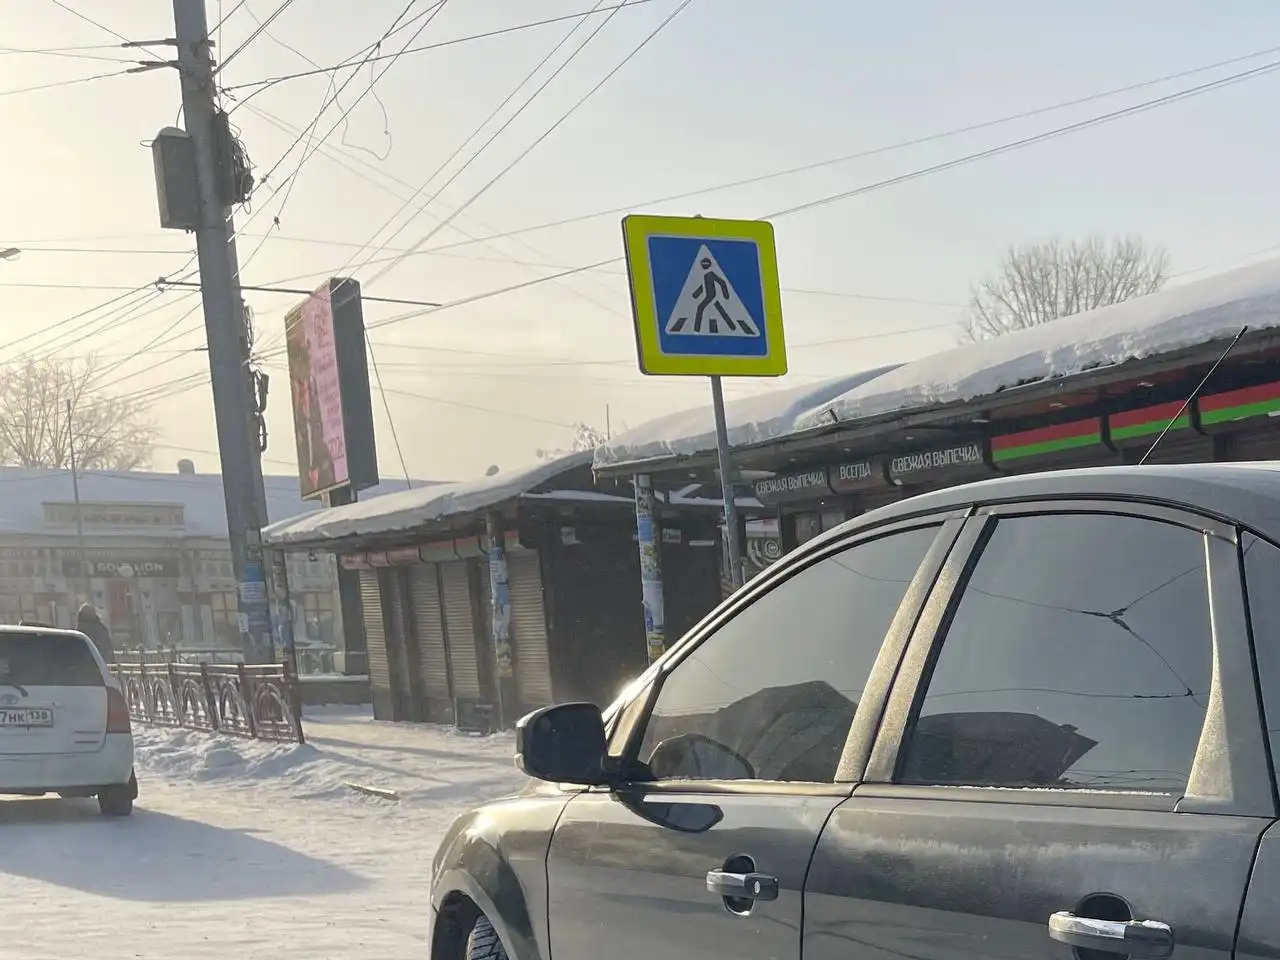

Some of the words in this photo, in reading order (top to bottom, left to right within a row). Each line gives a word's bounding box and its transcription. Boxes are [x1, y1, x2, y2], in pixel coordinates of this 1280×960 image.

[839, 462, 872, 480] ВСЕГДА
[892, 453, 932, 473] СВЕЖАЯ
[932, 445, 980, 466] ВЫПЕЧКА
[755, 477, 788, 495] СВЕЖАЯ
[788, 471, 825, 489] ВЫПЕЧКА
